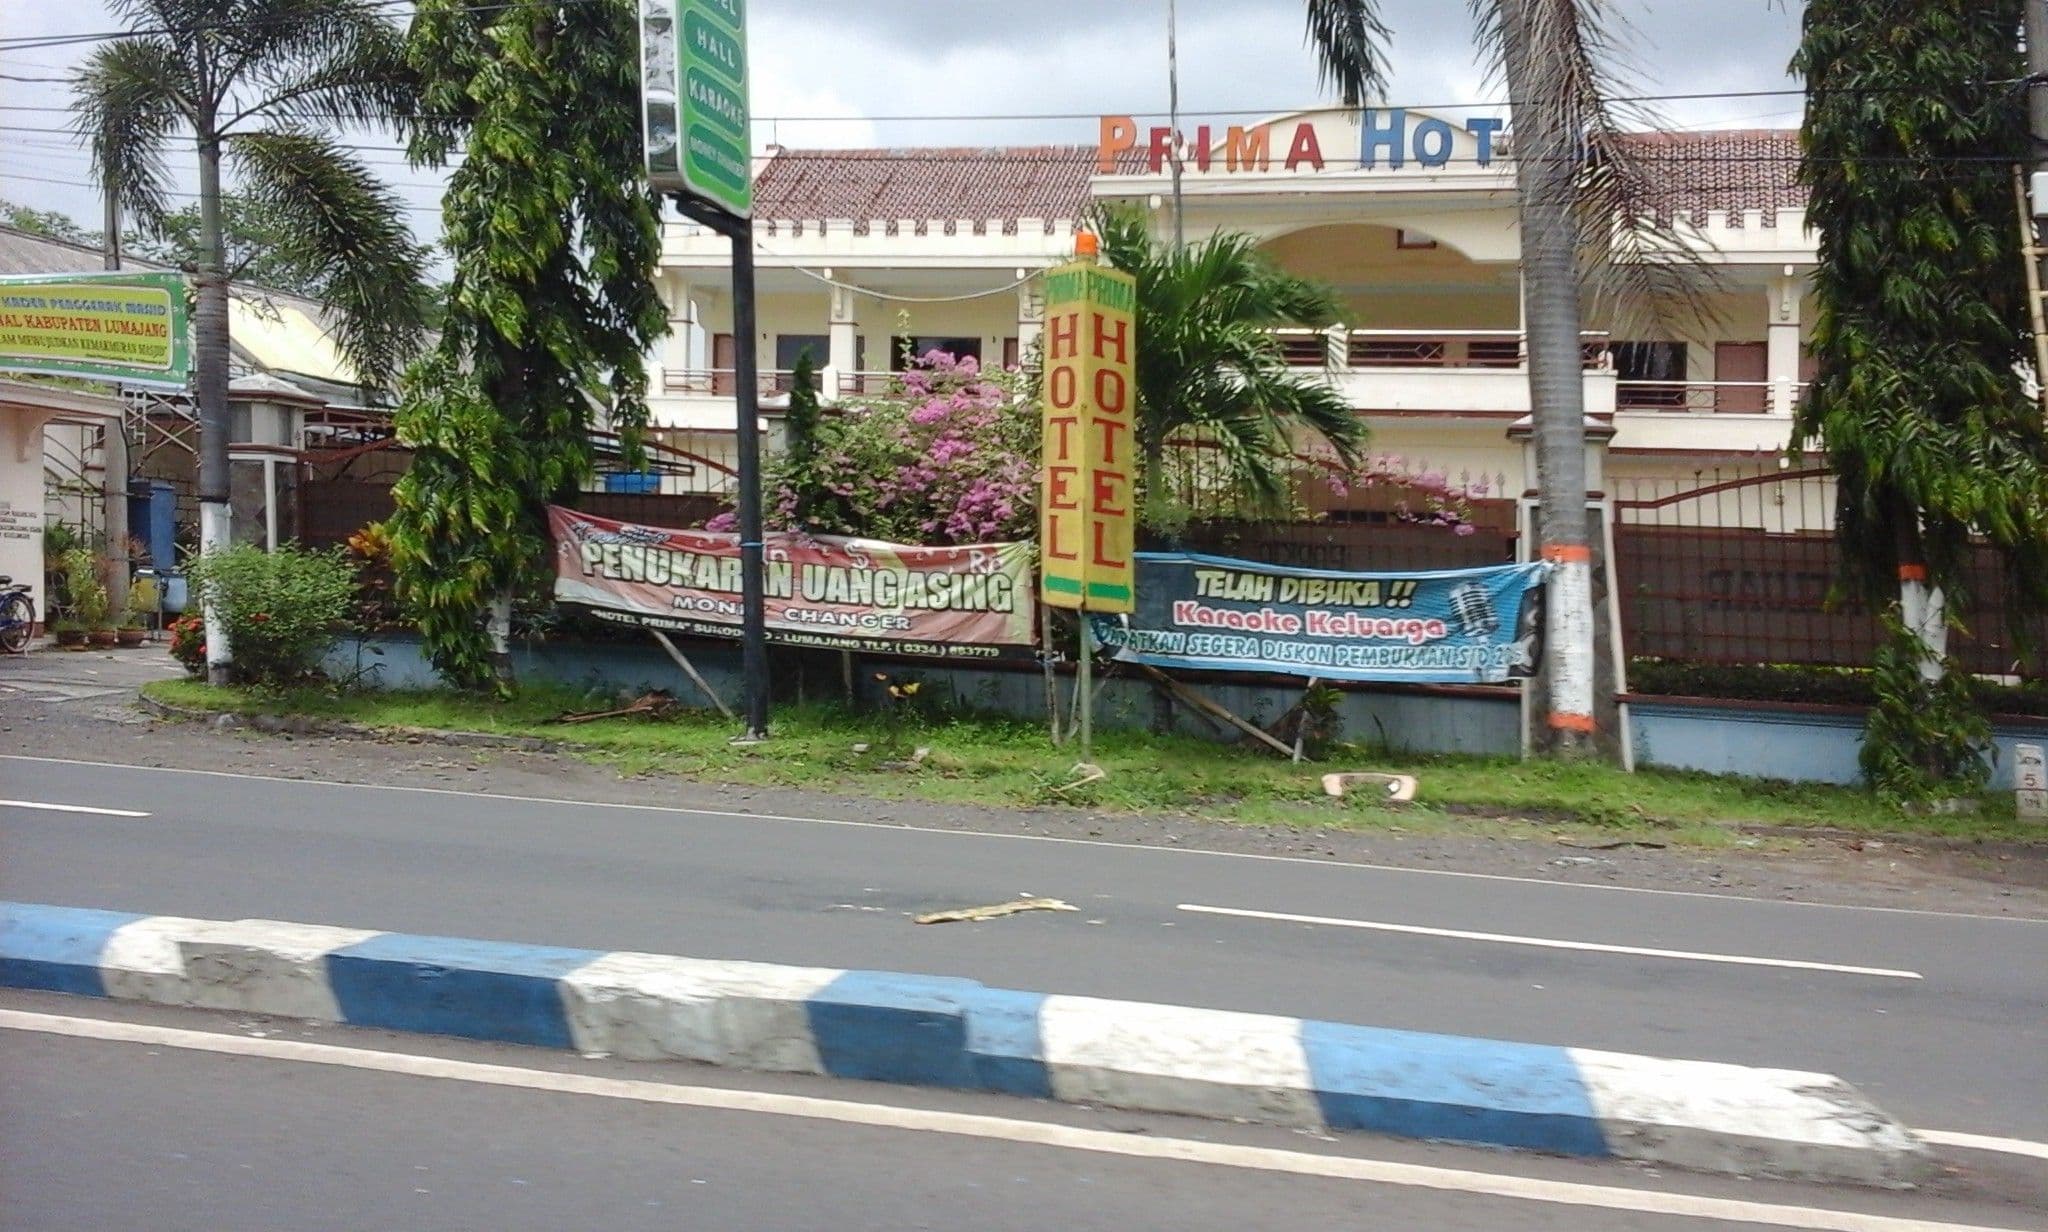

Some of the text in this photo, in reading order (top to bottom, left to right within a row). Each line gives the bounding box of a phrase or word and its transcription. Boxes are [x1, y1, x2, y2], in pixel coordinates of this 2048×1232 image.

[697, 26, 736, 68] HALL
[689, 77, 744, 128] KARAOKE
[1100, 115, 1325, 174] PRIMA
[24, 315, 101, 332] KABUPATEN
[105, 320, 167, 338] LUMAJANG
[1049, 312, 1078, 562] HOTEL
[1091, 312, 1128, 569] HOTEL
[580, 542, 793, 599] PENUKARN
[801, 563, 898, 608] UANG
[904, 570, 1013, 614] ASING
[1194, 569, 1417, 608] TELAH DIBUKA !!
[673, 594, 911, 631] MON CHANGER
[1173, 600, 1447, 645] Karaoke Keluarga
[783, 632, 860, 649] LUMAJANG
[1187, 633, 1258, 658] SEGERA
[1262, 638, 1331, 664] DISKON
[1334, 644, 1455, 669] PEMBUKAAN
